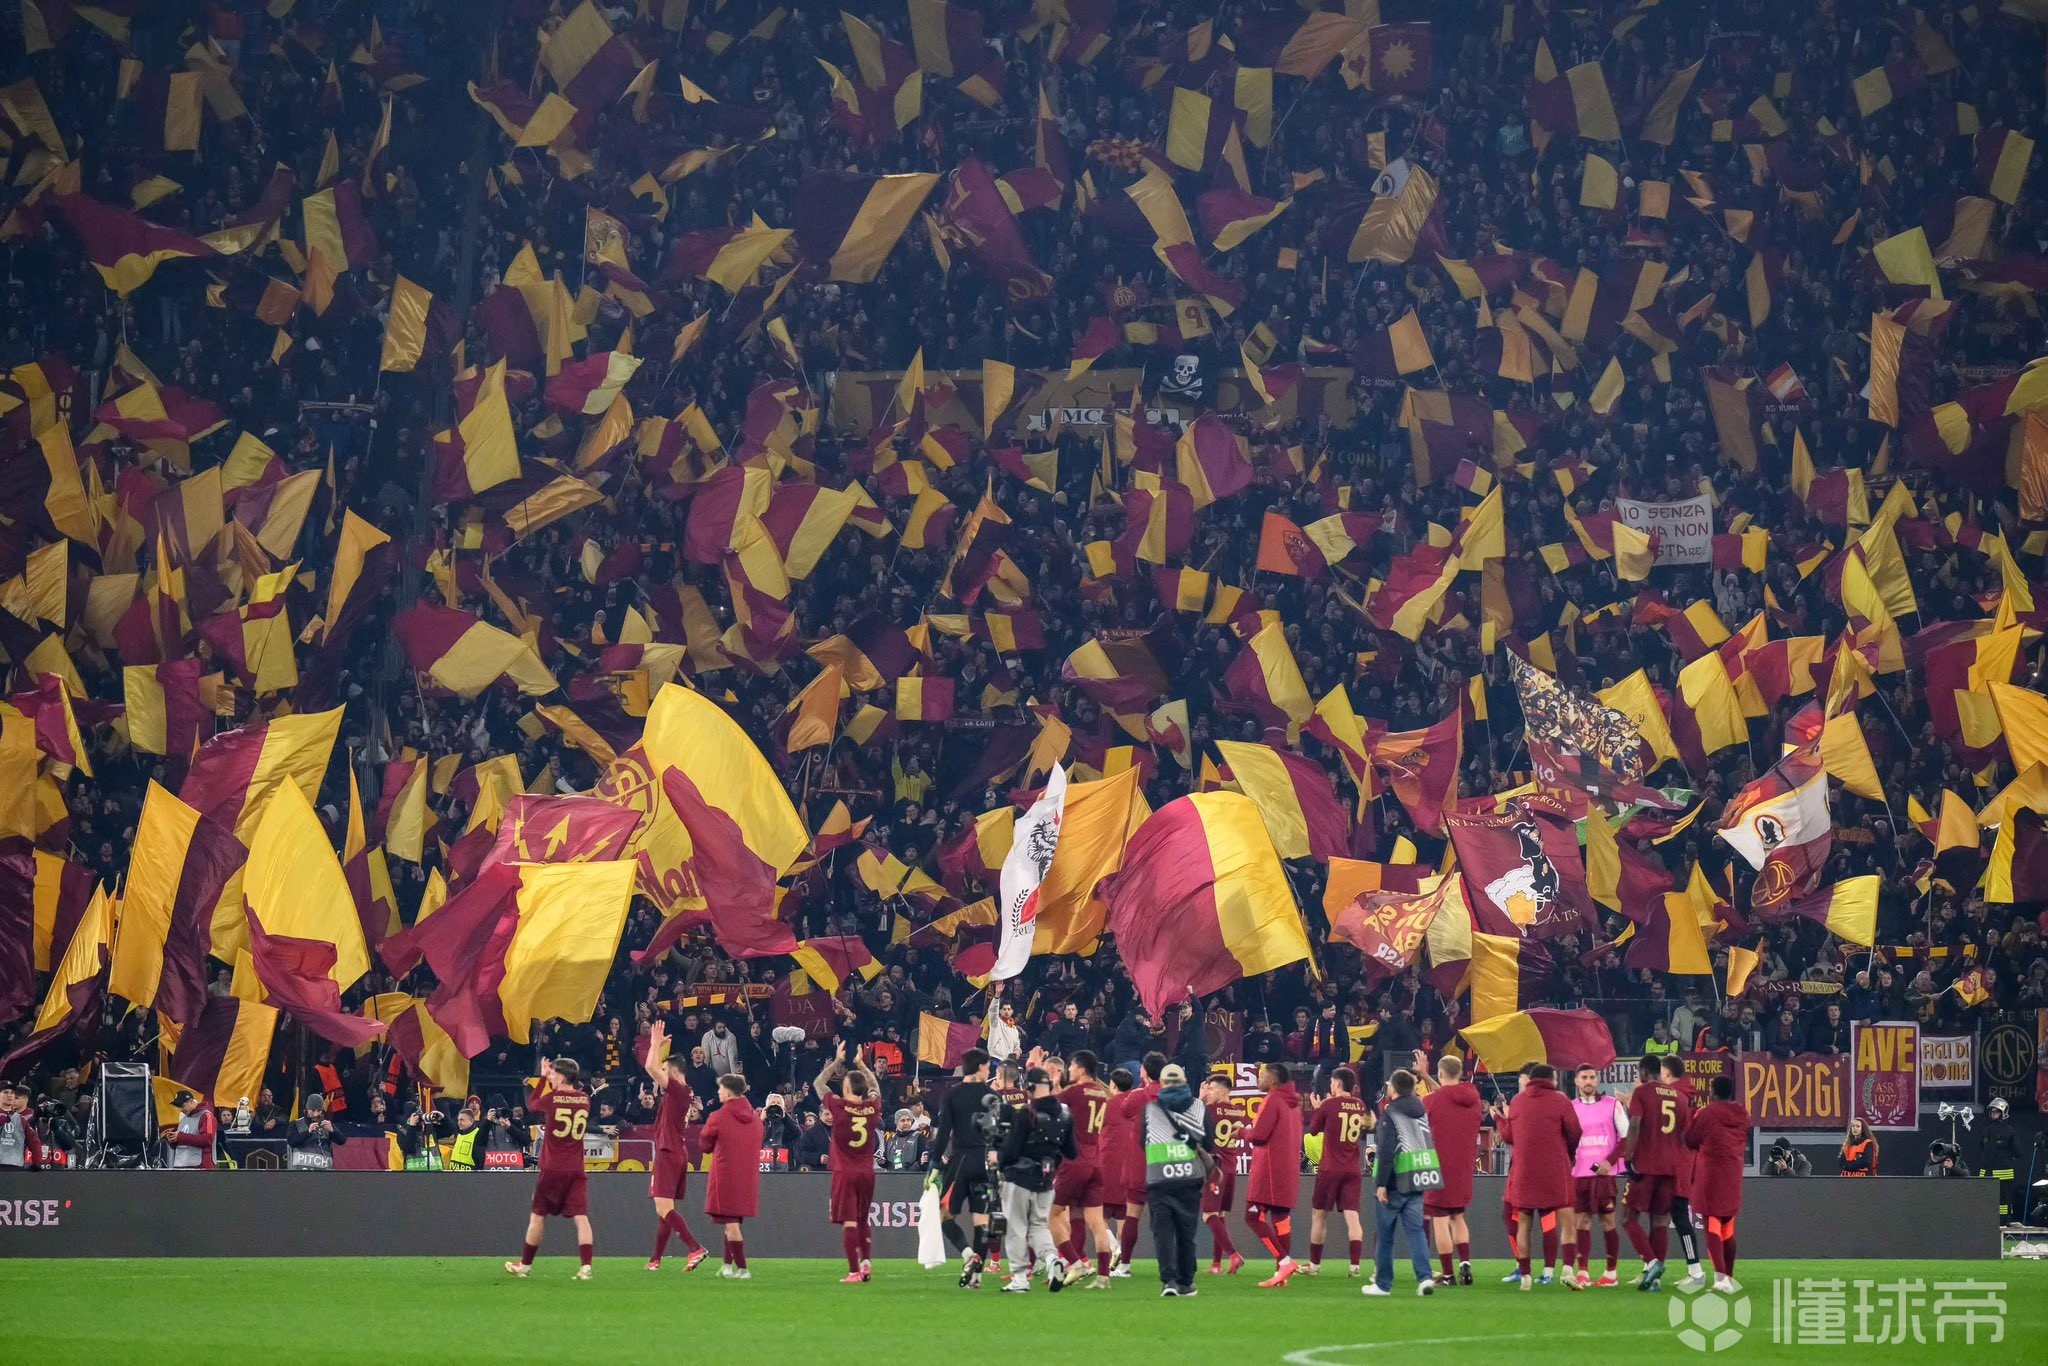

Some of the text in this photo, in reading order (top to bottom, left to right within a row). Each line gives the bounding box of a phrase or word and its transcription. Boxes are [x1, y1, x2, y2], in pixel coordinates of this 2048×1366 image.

[1624, 505, 1706, 520] IO SENZA
[1631, 522, 1709, 537] OMA NON
[1857, 1027, 1914, 1072] AVE
[1923, 1042, 1969, 1060] FIGLI DI
[1699, 1060, 1723, 1073] CORE
[1923, 1062, 1970, 1081] ROMA
[1875, 1082, 1895, 1093] ASR
[1873, 1094, 1897, 1107] 1927
[552, 1108, 589, 1141] 56
[1088, 1100, 1107, 1134] 14
[1661, 1100, 1676, 1134] 5
[848, 1116, 868, 1148] 3
[1338, 1112, 1361, 1143] 18
[486, 1152, 518, 1163] PHOTO
[1166, 1143, 1189, 1158] HB
[297, 1154, 329, 1166] PITCH
[1412, 1152, 1432, 1167] HB
[1162, 1162, 1193, 1178] 039
[1413, 1171, 1440, 1186] 060
